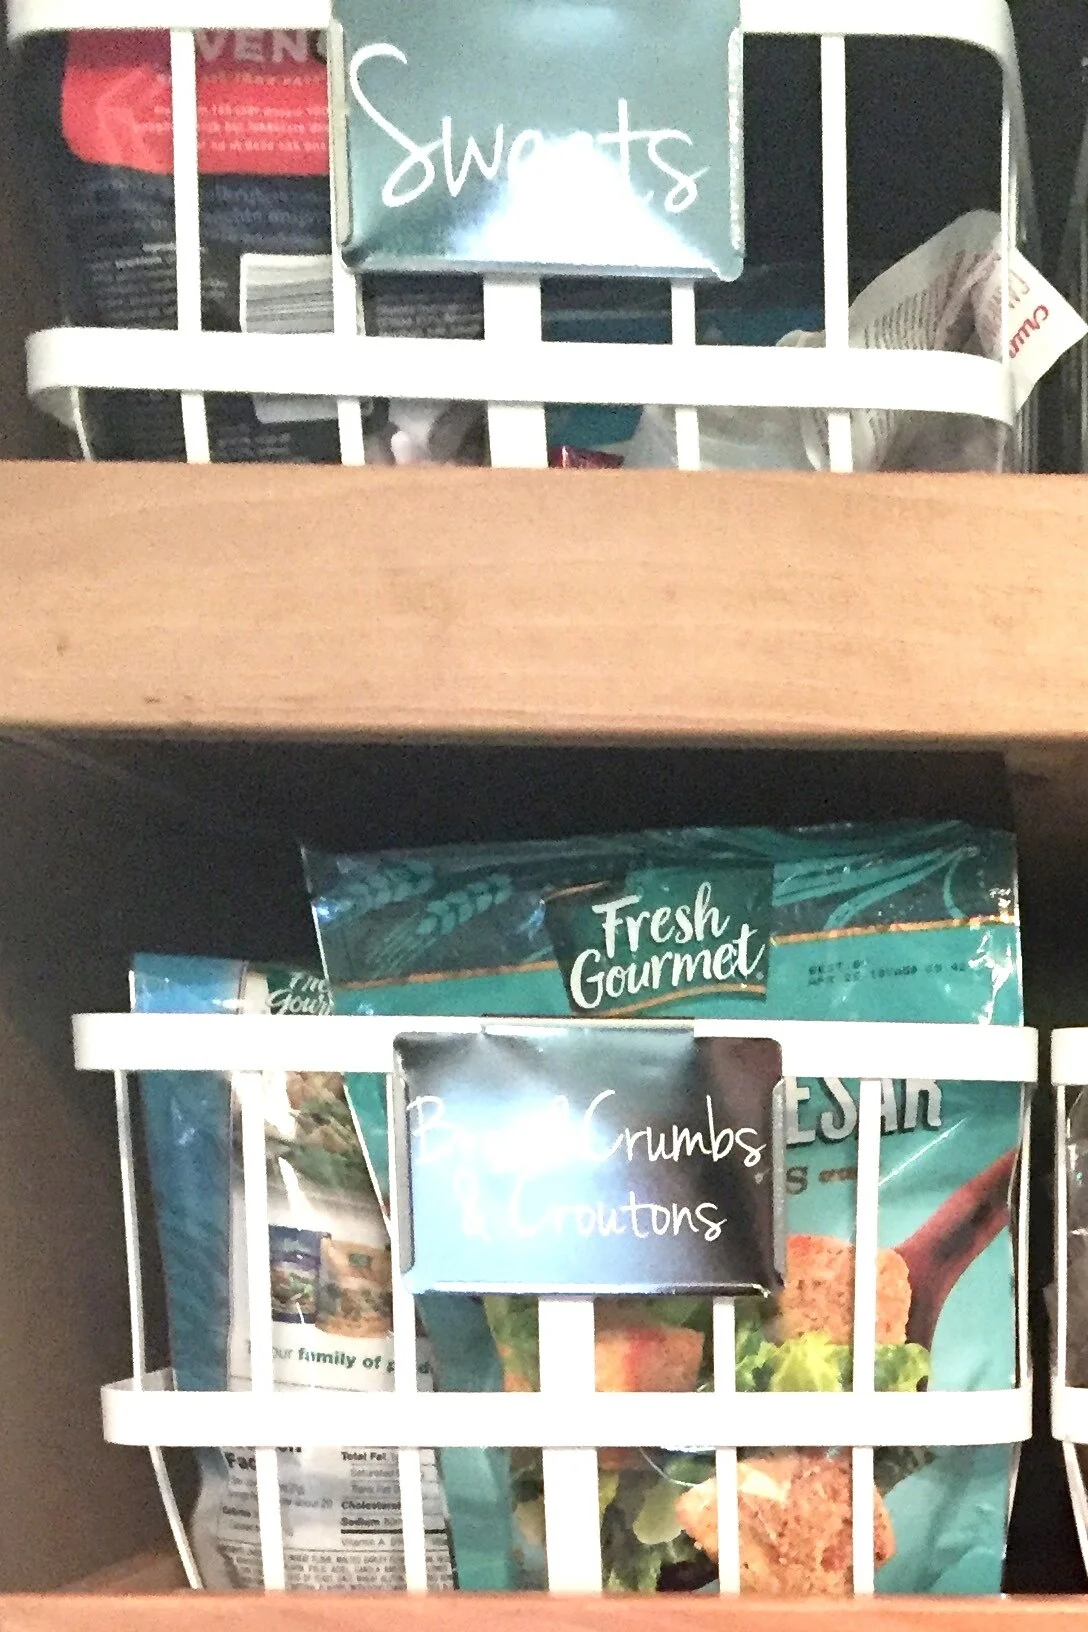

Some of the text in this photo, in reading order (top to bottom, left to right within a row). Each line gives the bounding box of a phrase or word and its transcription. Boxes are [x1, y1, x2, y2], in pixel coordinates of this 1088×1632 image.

[592, 882, 731, 958] Fresh
[571, 923, 767, 1010] Gourmet
[582, 1090, 765, 1166] Crumbs
[510, 1174, 724, 1241] Croutons
[298, 1347, 356, 1369] family
[362, 1355, 381, 1369] of
